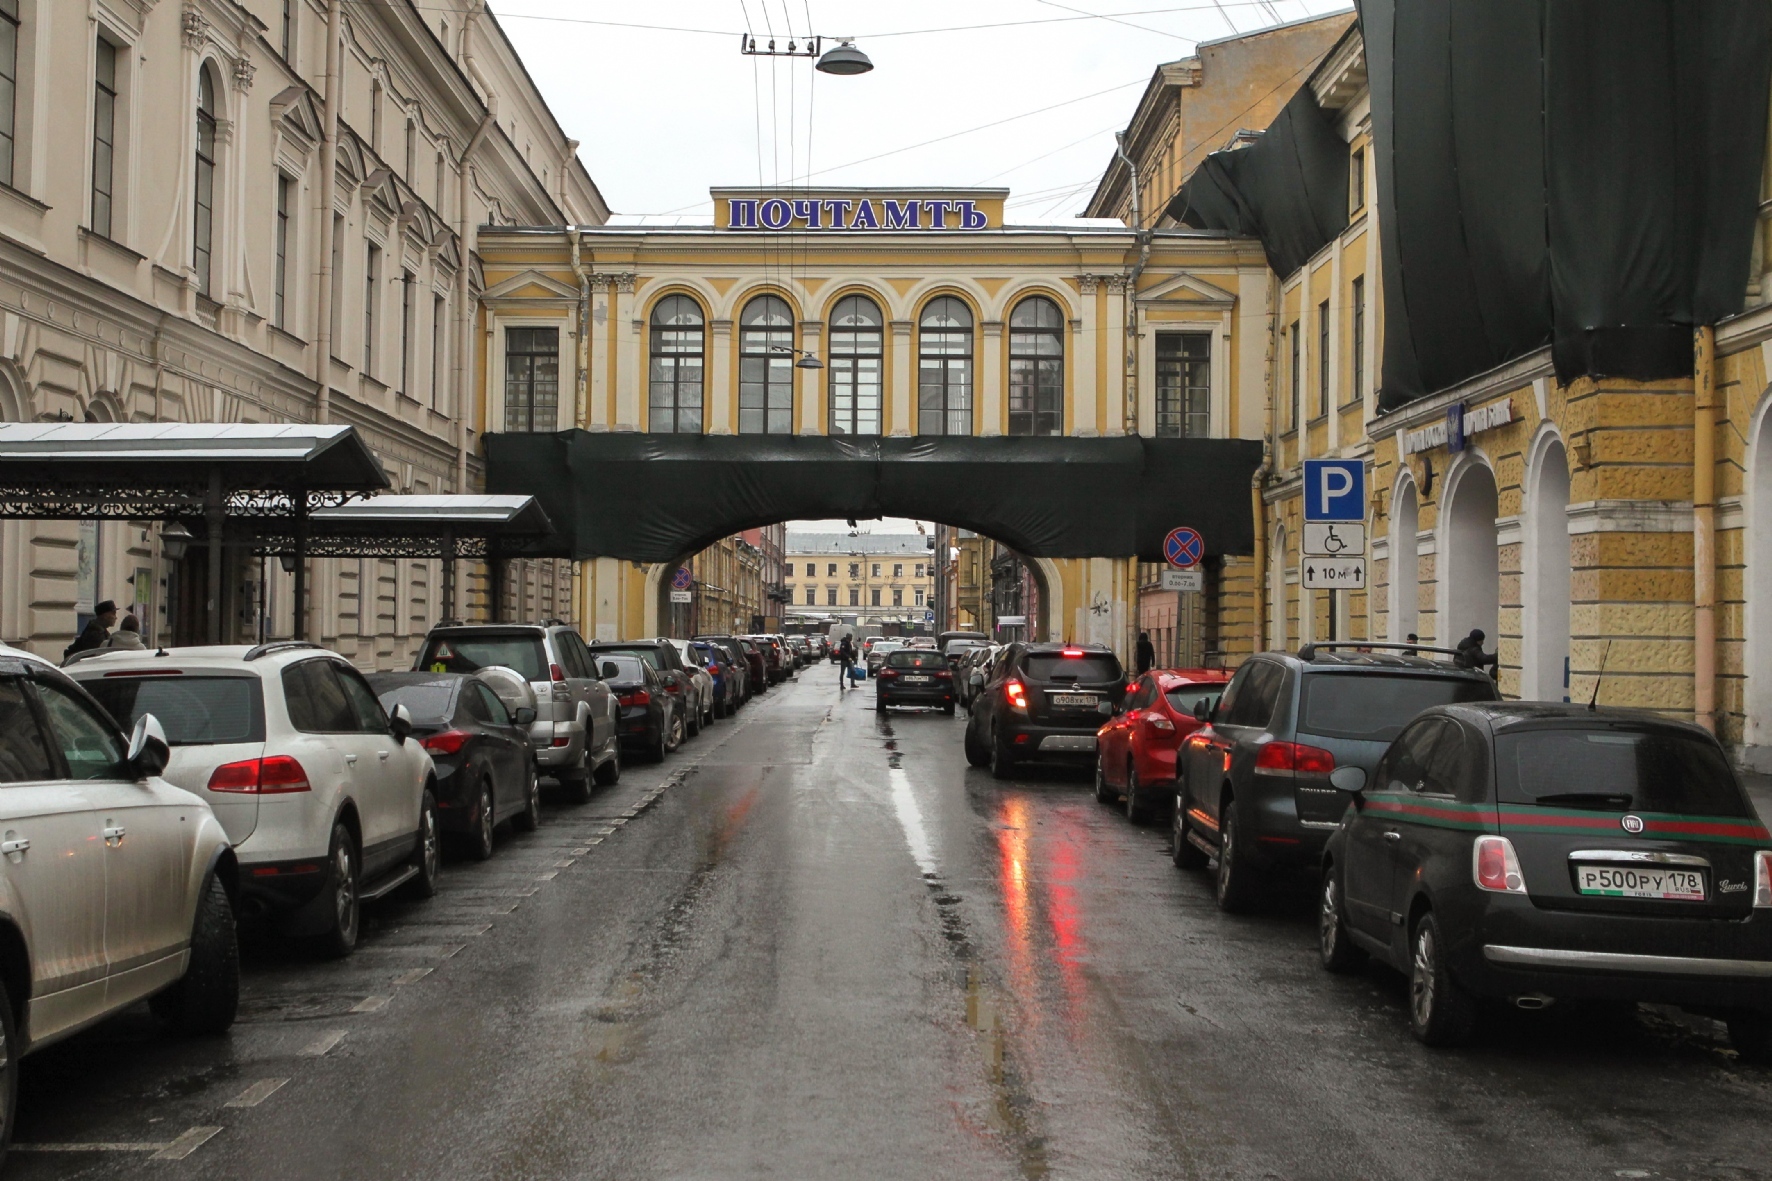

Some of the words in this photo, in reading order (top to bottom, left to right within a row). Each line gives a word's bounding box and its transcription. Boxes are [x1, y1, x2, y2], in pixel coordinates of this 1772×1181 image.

[728, 199, 988, 229] ПОЧТАМТЪ
[1321, 467, 1353, 514] P
[1322, 568, 1335, 580] 10
[1585, 870, 1663, 890] Р500РУ
[1668, 873, 1697, 887] 178
